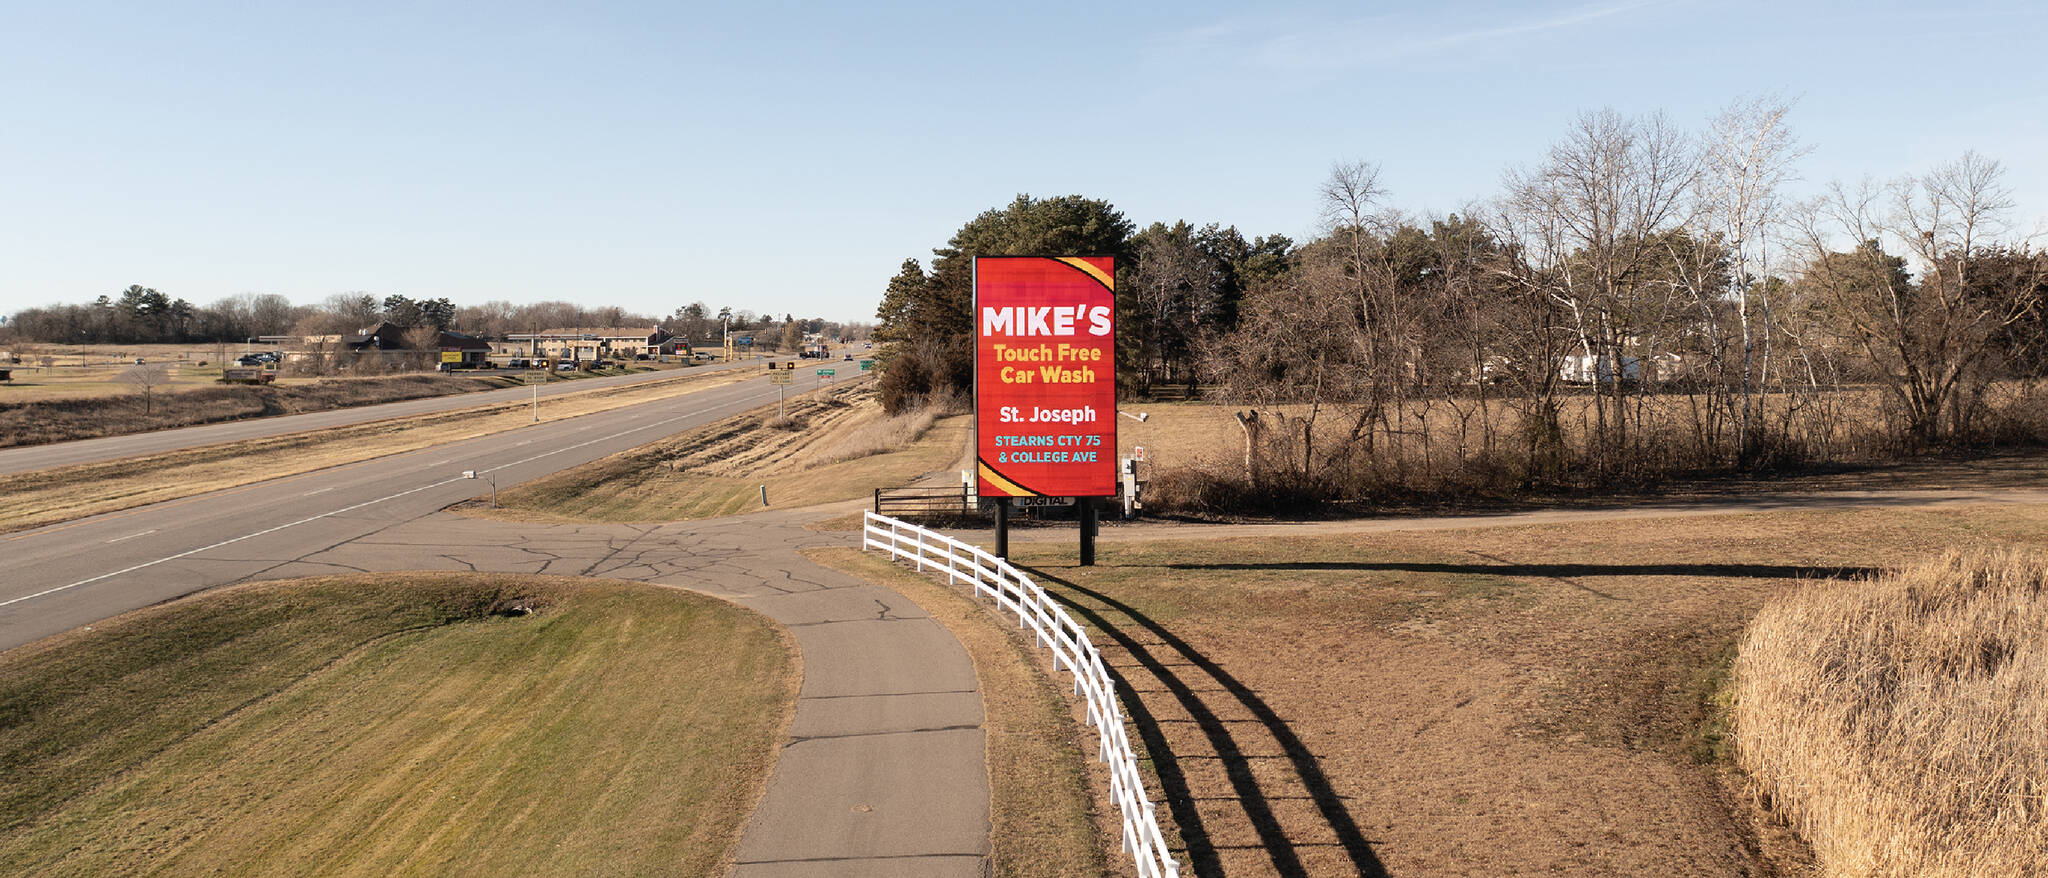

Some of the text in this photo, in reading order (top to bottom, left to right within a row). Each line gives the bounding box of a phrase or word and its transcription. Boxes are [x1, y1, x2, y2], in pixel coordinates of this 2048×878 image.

[983, 304, 1111, 336] MIKE'S
[994, 344, 1101, 361] Touch Free
[1001, 366, 1094, 383] Car Wash
[1000, 406, 1095, 425] St. Joseph
[996, 435, 1100, 447] STEARNS CTY 75
[999, 452, 1096, 463] & COLLEGE AVE
